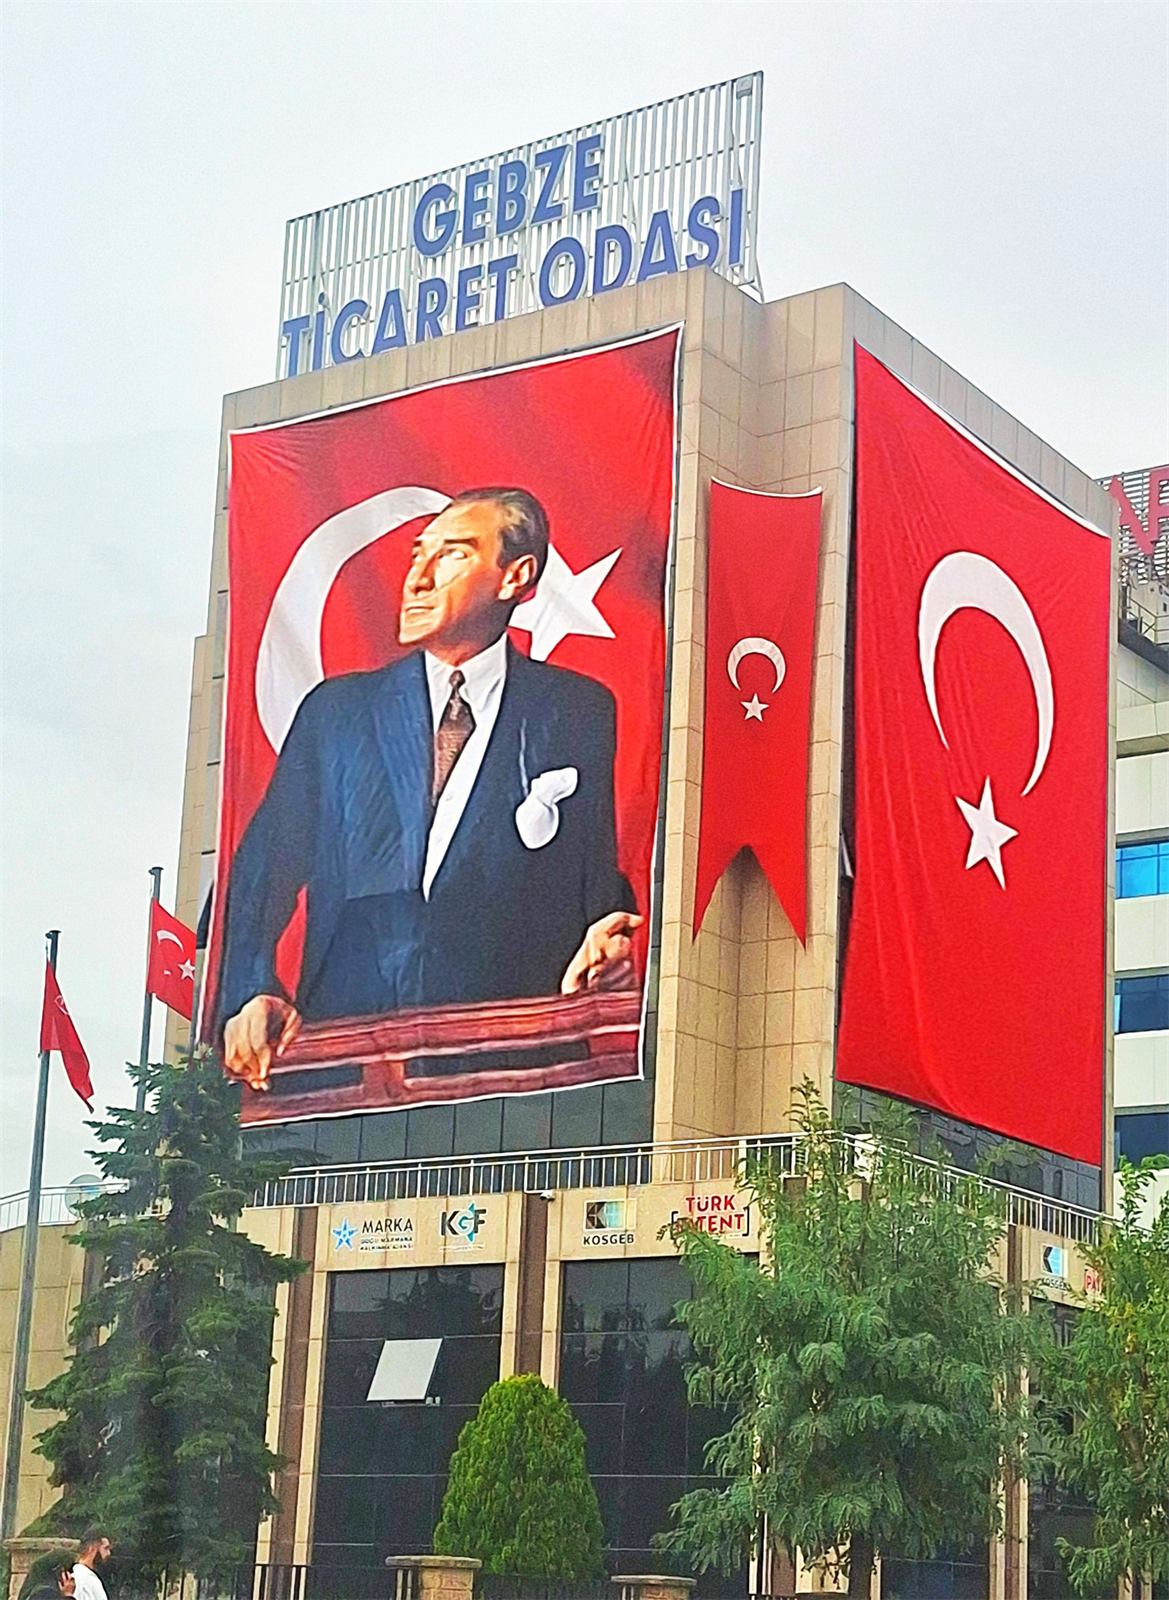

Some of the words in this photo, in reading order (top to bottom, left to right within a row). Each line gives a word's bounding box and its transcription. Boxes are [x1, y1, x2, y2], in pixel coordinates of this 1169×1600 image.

[412, 133, 602, 256] GEBZE
[282, 254, 518, 378] TİCARET
[538, 188, 744, 308] ODASI
[685, 1194, 735, 1213] TÜRK
[362, 1217, 414, 1233] MARKA
[441, 1206, 487, 1239] KGF
[583, 1233, 634, 1246] KOSGEB
